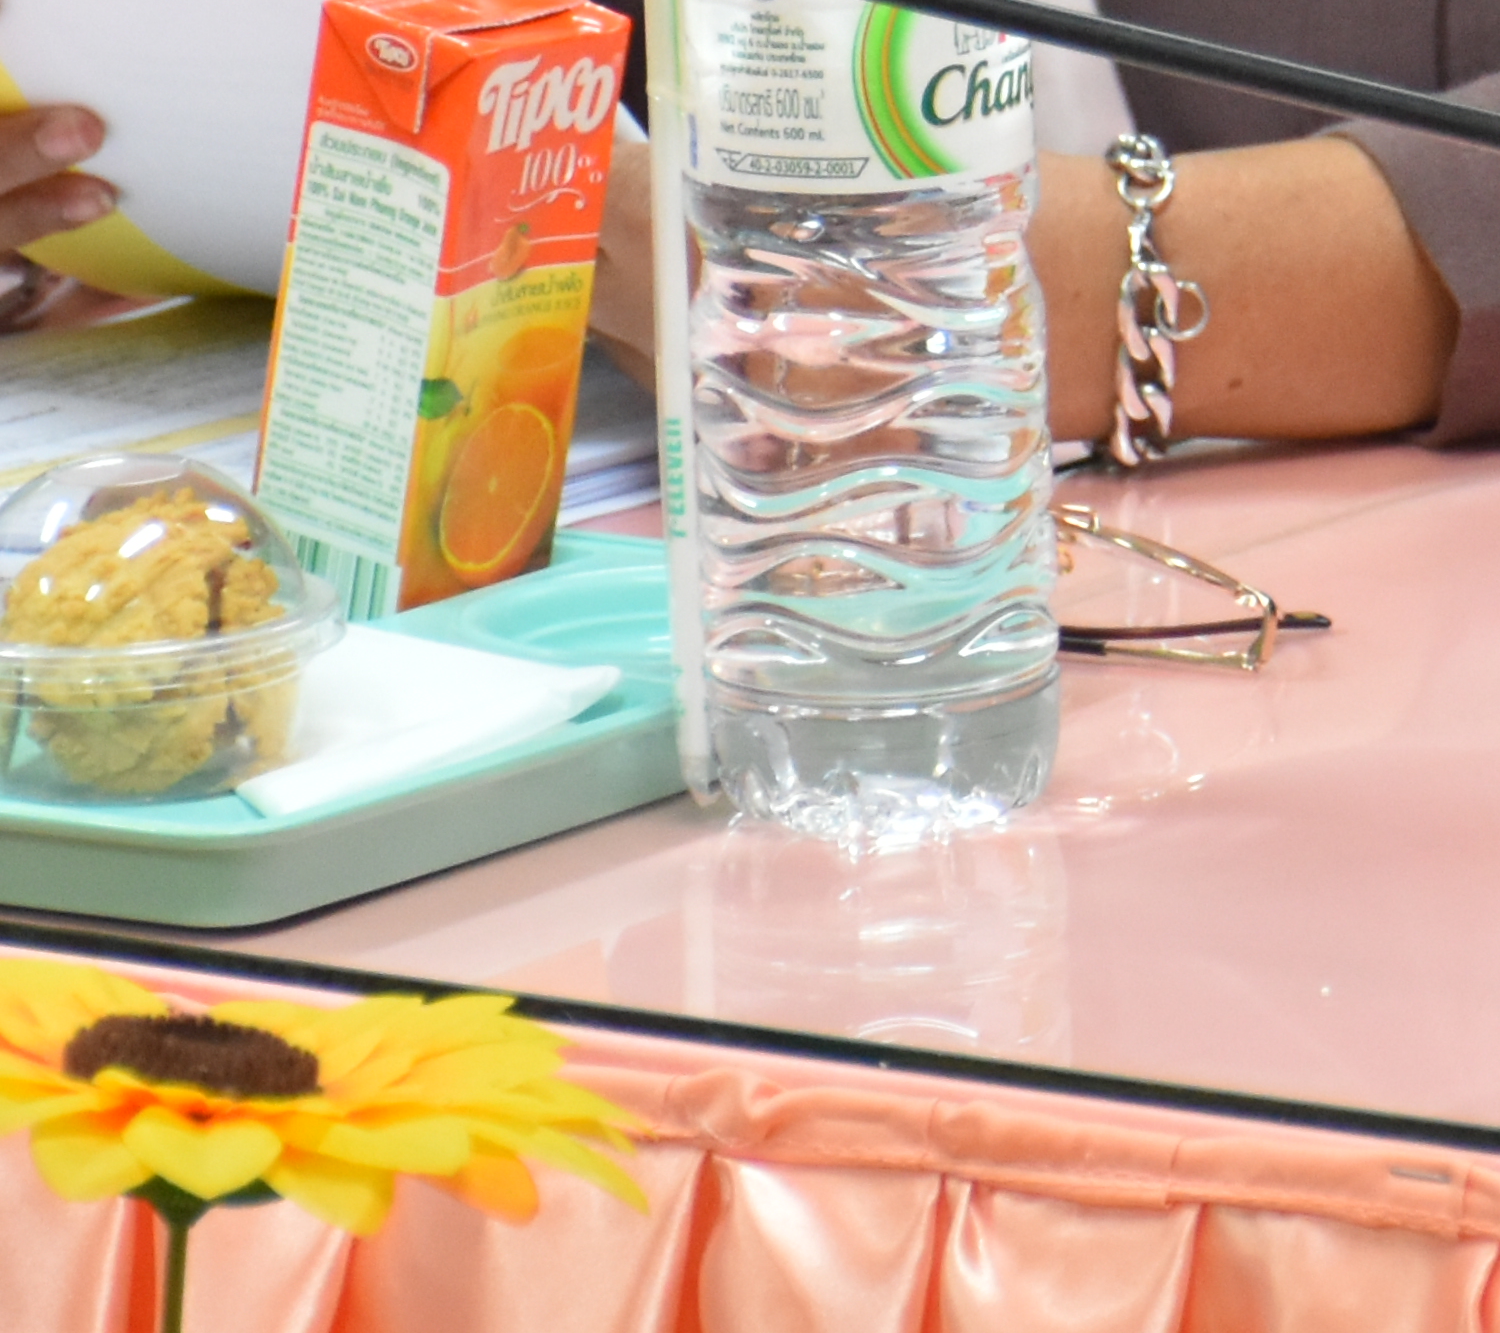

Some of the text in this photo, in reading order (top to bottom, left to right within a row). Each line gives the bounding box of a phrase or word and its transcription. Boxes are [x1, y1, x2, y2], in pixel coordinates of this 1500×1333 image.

[775, 87, 800, 120] 600
[921, 60, 1034, 127] Chan
[783, 127, 805, 141] 600
